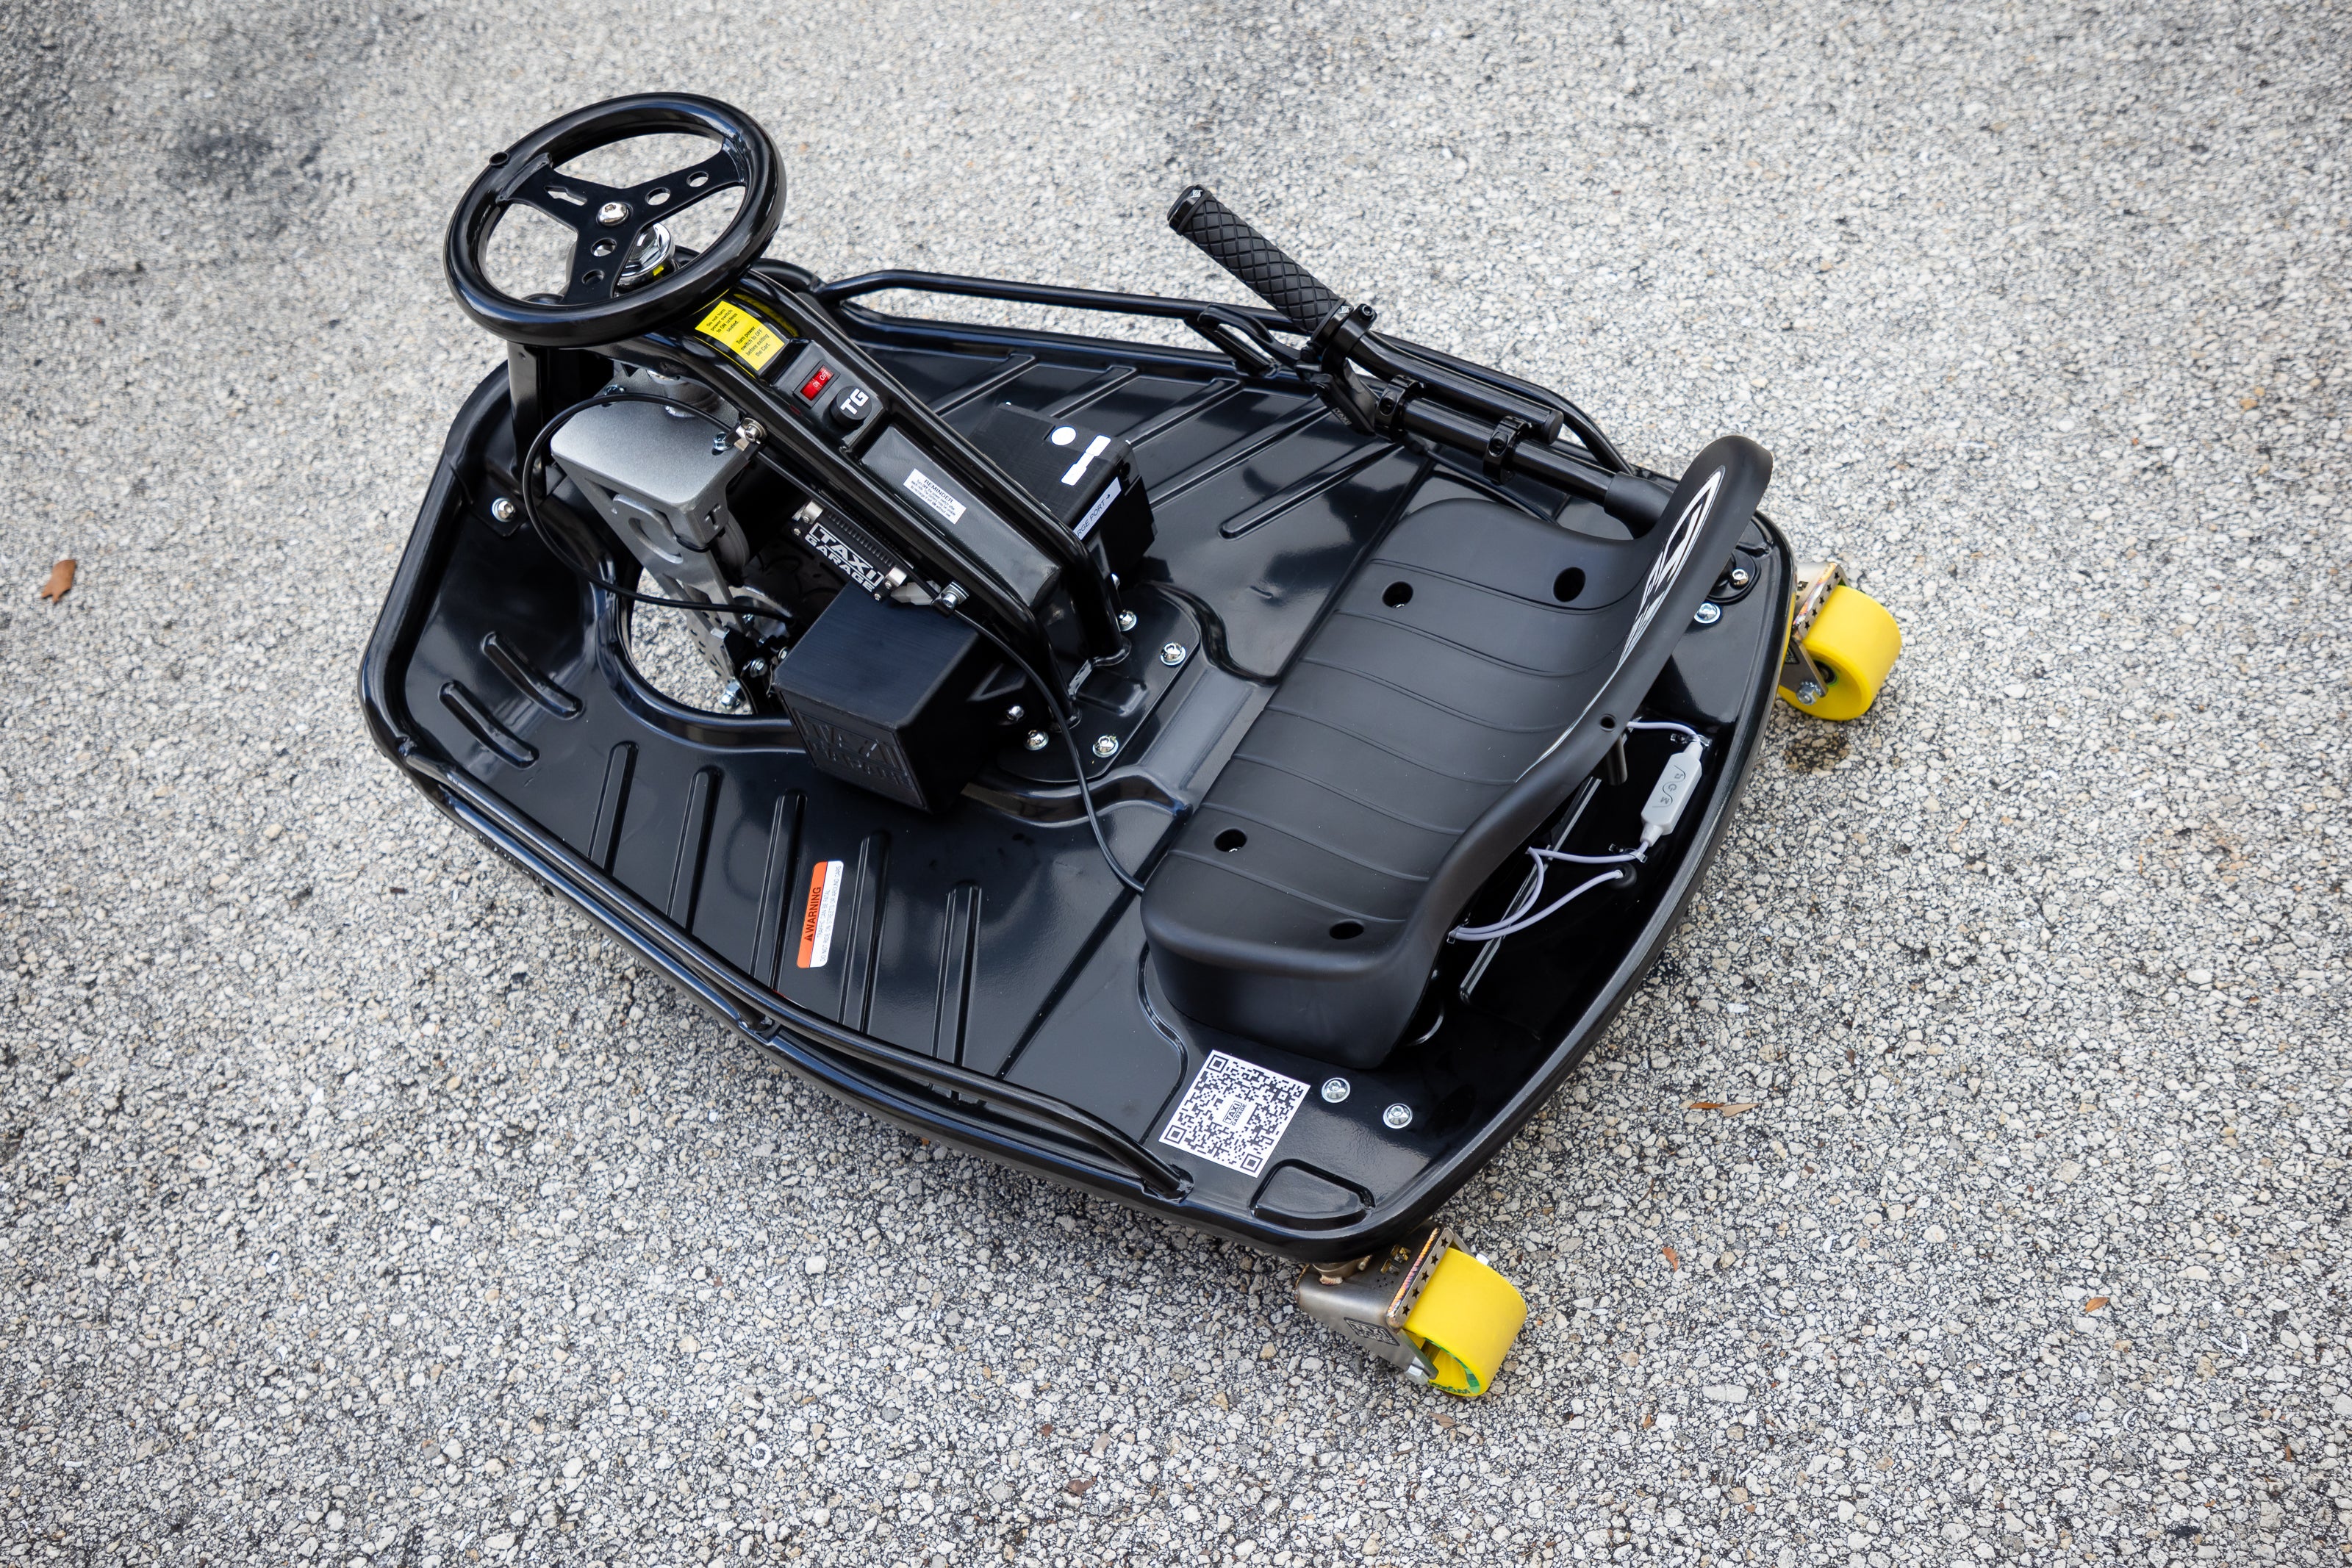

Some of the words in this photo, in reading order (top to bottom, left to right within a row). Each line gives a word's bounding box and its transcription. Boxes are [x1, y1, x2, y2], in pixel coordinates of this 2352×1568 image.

[710, 320, 722, 331] power
[720, 309, 733, 320] switch
[717, 308, 725, 316] turn
[725, 312, 738, 323] unless
[736, 335, 745, 345] Turn
[743, 326, 756, 338] power
[740, 338, 753, 350] switch
[754, 328, 763, 337] OFF
[745, 343, 758, 356] before
[756, 333, 770, 346] exiting
[820, 370, 829, 381] OFF
[840, 388, 870, 414] TG
[923, 479, 953, 503] REMINDER
[1077, 519, 1089, 536] RGE
[1089, 499, 1105, 521] PORT
[804, 533, 876, 593] GARAGE
[820, 528, 879, 584] TAXI
[805, 886, 821, 933] WARNING
[1225, 1103, 1241, 1121] TAXI
[1231, 1104, 1247, 1126] GARAGE
